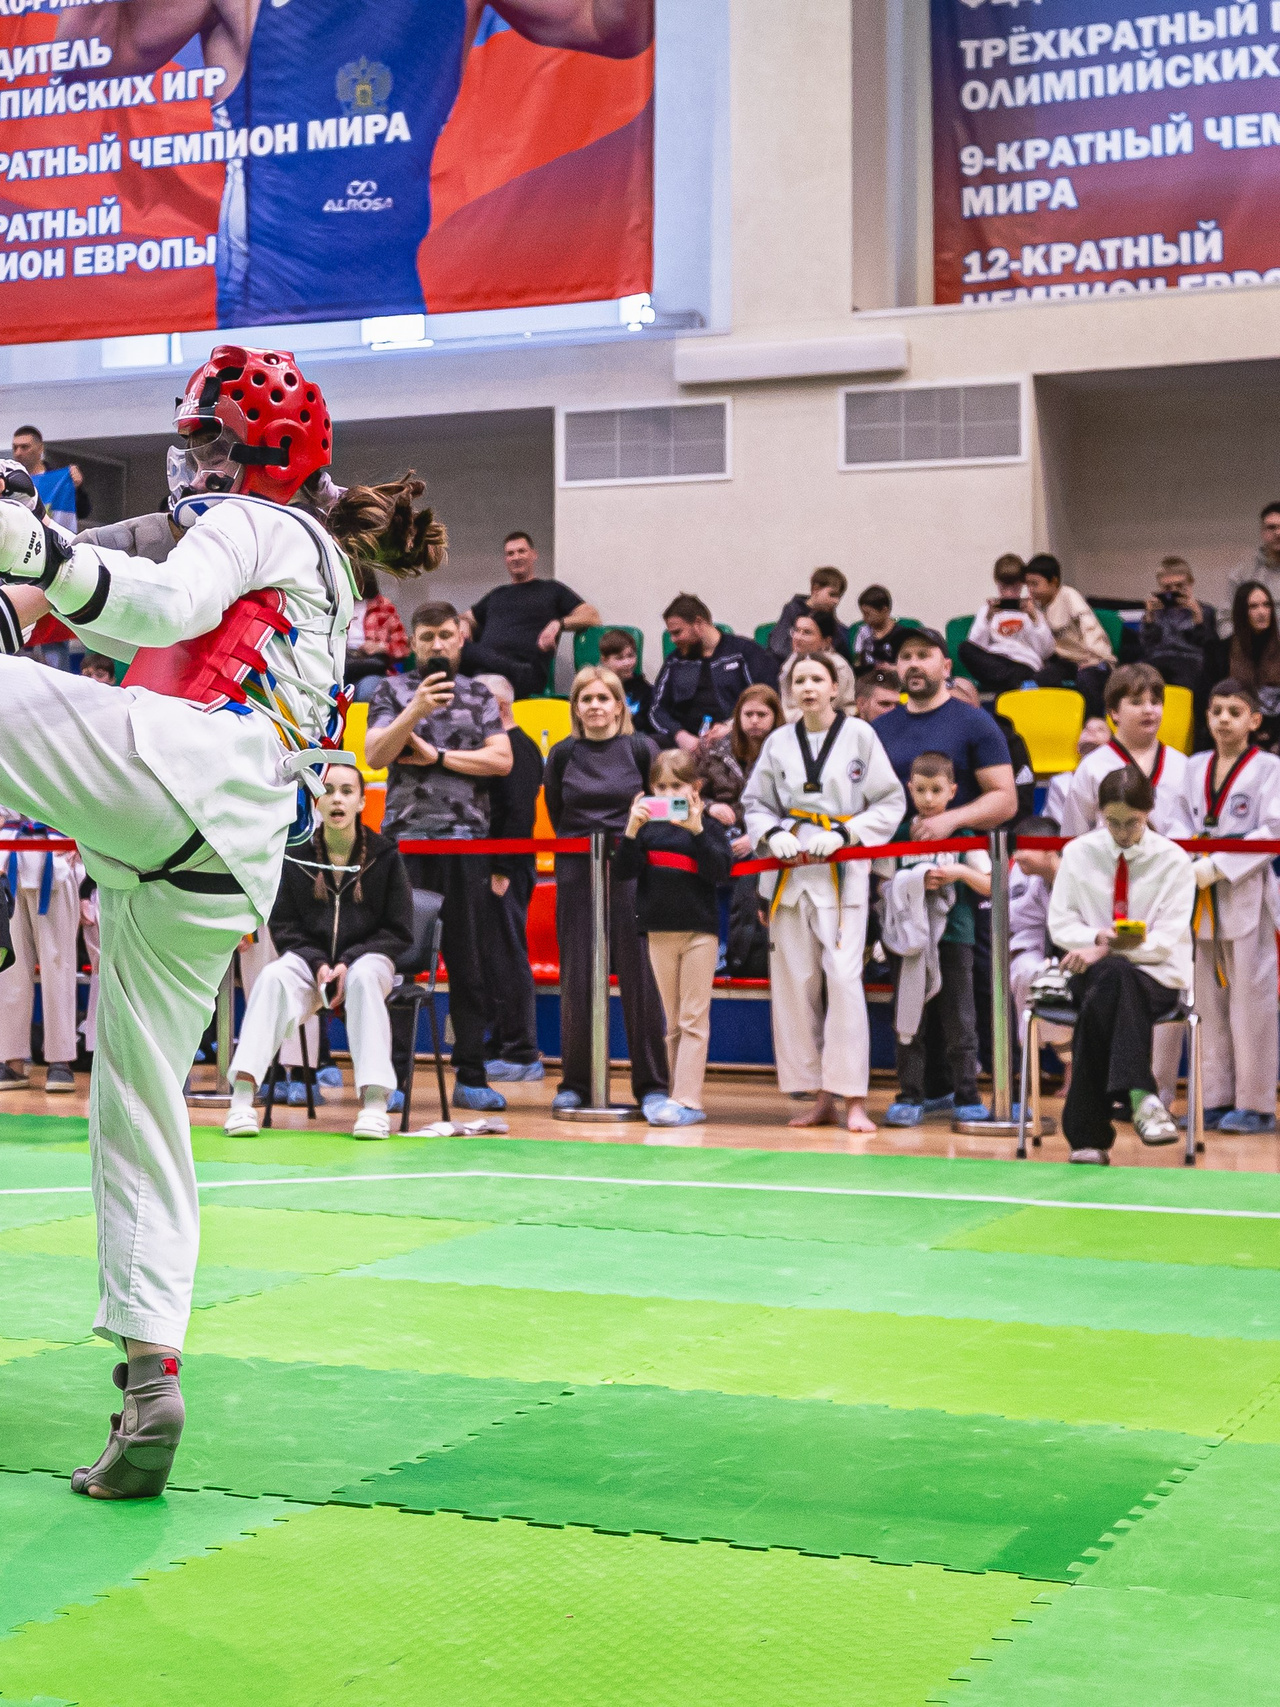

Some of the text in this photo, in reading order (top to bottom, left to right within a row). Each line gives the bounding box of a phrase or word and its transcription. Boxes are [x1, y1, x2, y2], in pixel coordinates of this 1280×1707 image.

[959, 0, 1258, 69] ТРЁХКРАТНЫЙ
[163, 66, 226, 101] ИГР
[961, 44, 1280, 111] ОЛИМПИЙСКИХ
[129, 122, 298, 169] ЧЕМПИОН
[307, 111, 411, 150] МИРА
[960, 111, 1194, 176] 9-КРАТНЫЙ
[322, 197, 393, 212] ALROSA
[961, 177, 1078, 218] МИРА
[73, 235, 217, 277] ЕВРОПЫ
[962, 219, 1223, 284] 12-КРАТНЫЙ
